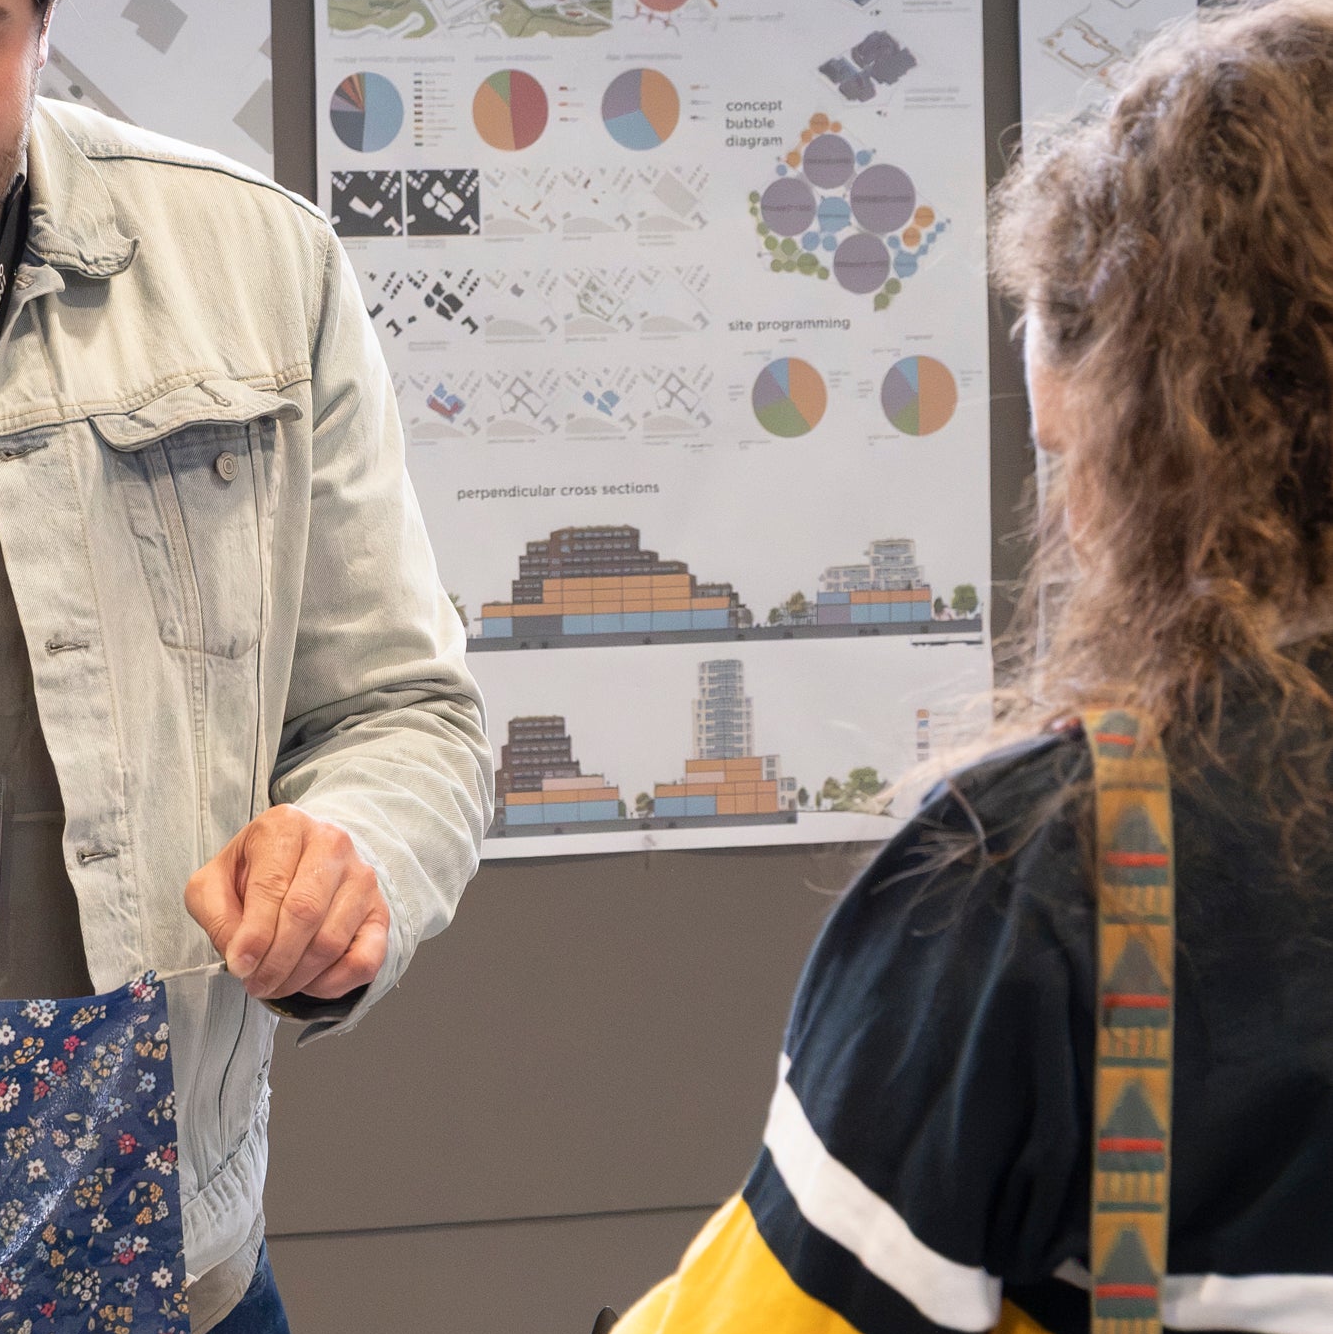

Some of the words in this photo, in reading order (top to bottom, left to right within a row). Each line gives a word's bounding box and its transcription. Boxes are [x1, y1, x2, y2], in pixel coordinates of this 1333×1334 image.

[725, 100, 783, 113] concept
[725, 118, 775, 130] bubble
[725, 135, 783, 150] diagram
[727, 319, 753, 332] site
[757, 317, 851, 333] programming
[456, 484, 556, 501] perpendicular
[560, 485, 597, 497] cross
[602, 481, 660, 495] sections
